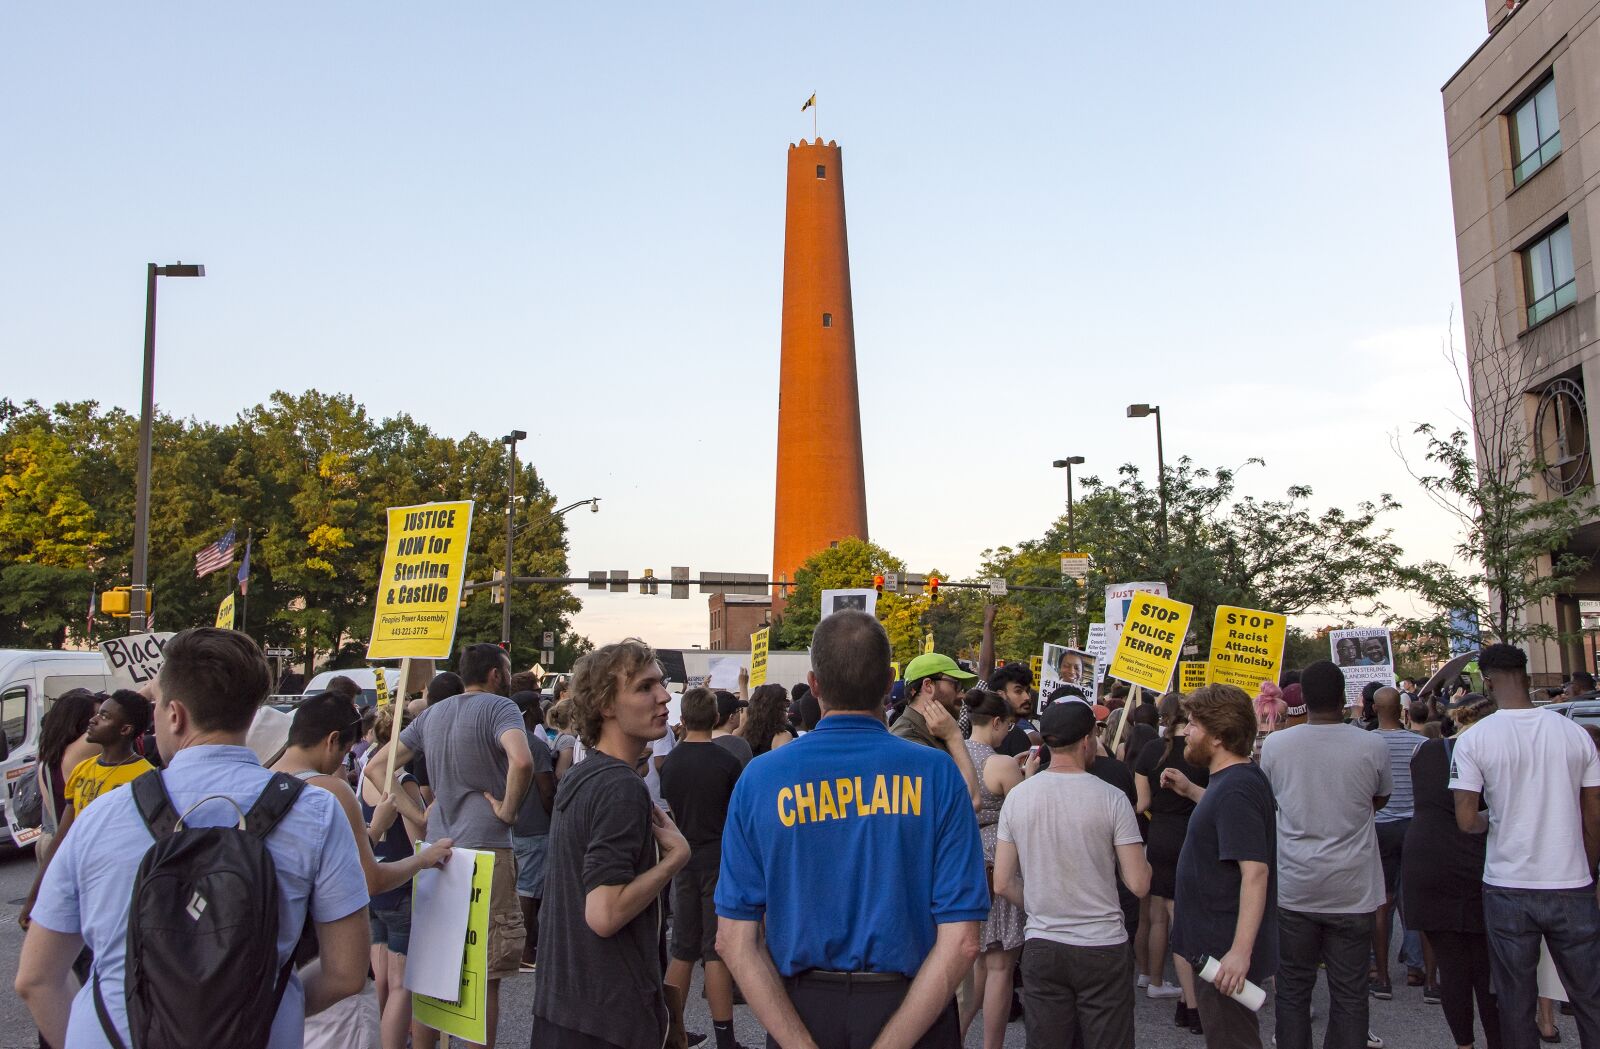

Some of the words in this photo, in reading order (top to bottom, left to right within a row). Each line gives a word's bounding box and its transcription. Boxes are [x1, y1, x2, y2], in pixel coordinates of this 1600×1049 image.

[403, 509, 456, 532] JUSTICE
[397, 537, 425, 557] NOW
[428, 536, 451, 554] for
[387, 588, 396, 605] &
[398, 583, 449, 605] Castile
[381, 616, 401, 625] Peoples
[401, 614, 416, 622] Power
[416, 614, 446, 624] Assembly
[1140, 603, 1180, 624] STOP
[1226, 613, 1274, 629] STOP
[1130, 621, 1176, 644] POLICE
[1228, 629, 1268, 643] Racist
[1346, 630, 1386, 638] REMEMBER
[1124, 636, 1173, 661] TERROR
[1216, 653, 1231, 661] on
[1225, 641, 1268, 655] Attacks
[127, 660, 166, 684] Liv
[777, 774, 923, 828] CHAPLAIN
